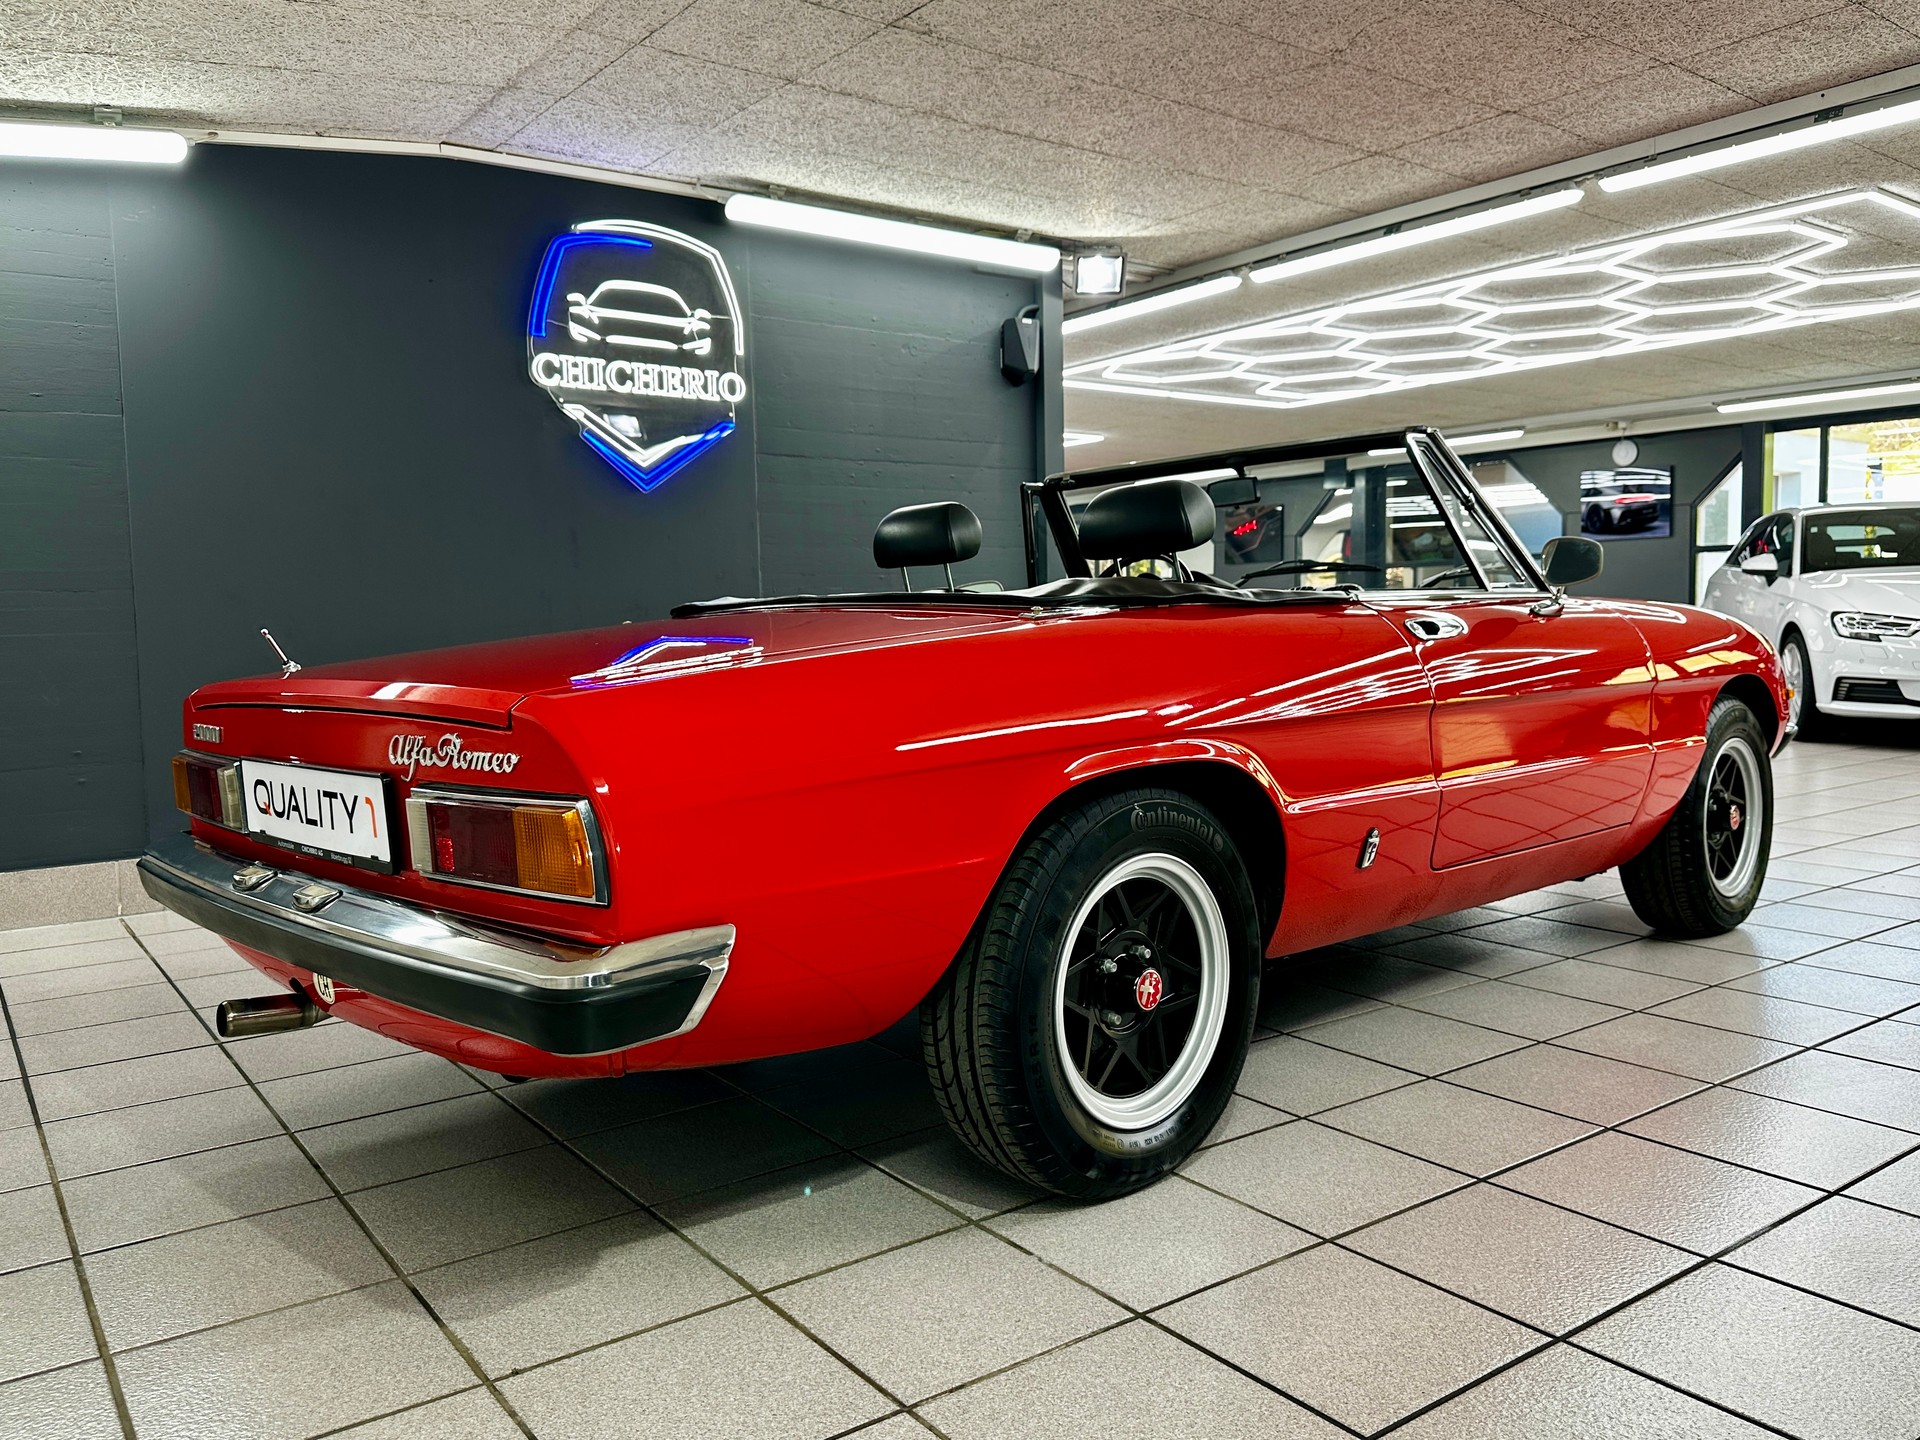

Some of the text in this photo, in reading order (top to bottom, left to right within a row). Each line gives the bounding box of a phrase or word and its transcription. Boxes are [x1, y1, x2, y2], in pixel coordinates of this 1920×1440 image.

[531, 352, 746, 402] CHICHERIO
[389, 733, 521, 782] Alfa Romeo
[253, 779, 358, 834] QUALITY
[1130, 803, 1214, 845] Continental
